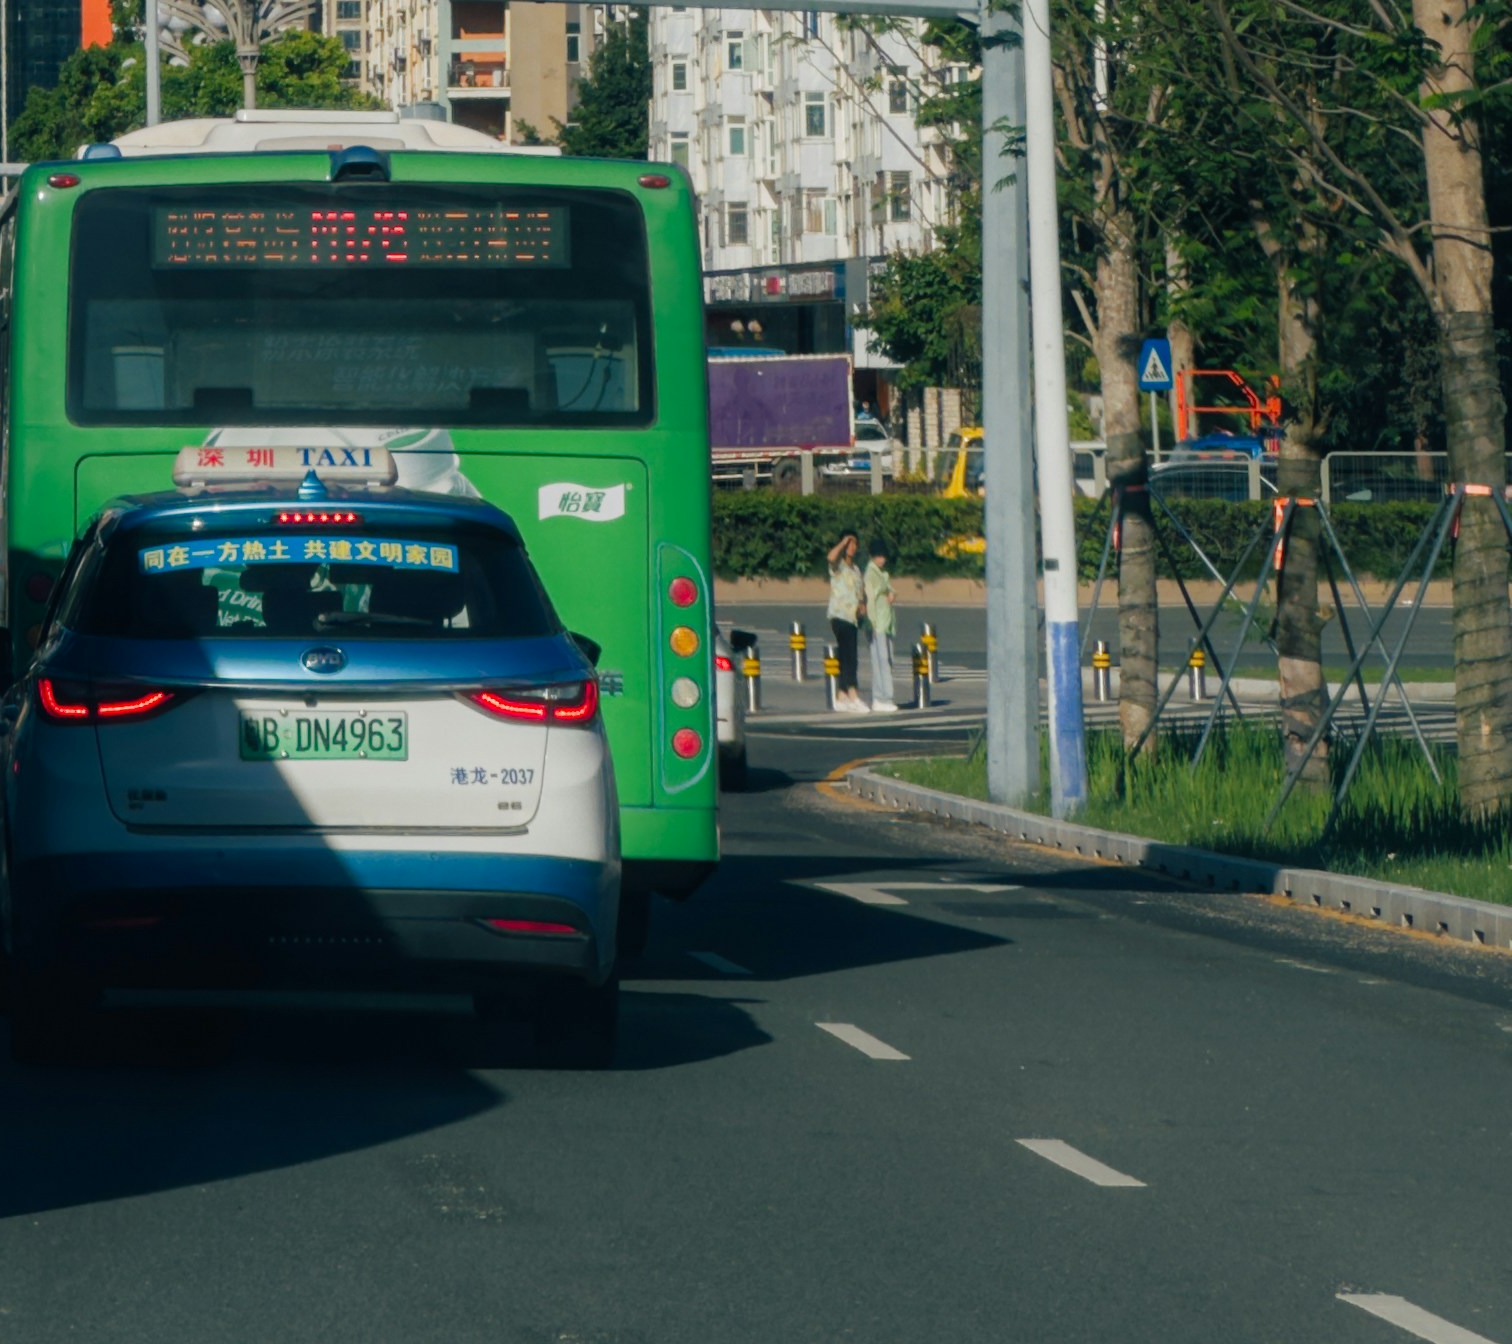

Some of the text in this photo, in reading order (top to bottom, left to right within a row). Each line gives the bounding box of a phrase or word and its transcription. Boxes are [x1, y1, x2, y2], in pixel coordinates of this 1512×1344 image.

[197, 447, 374, 467] 深圳 TAXI
[143, 539, 454, 570] 同在一方热土 共建文明家园
